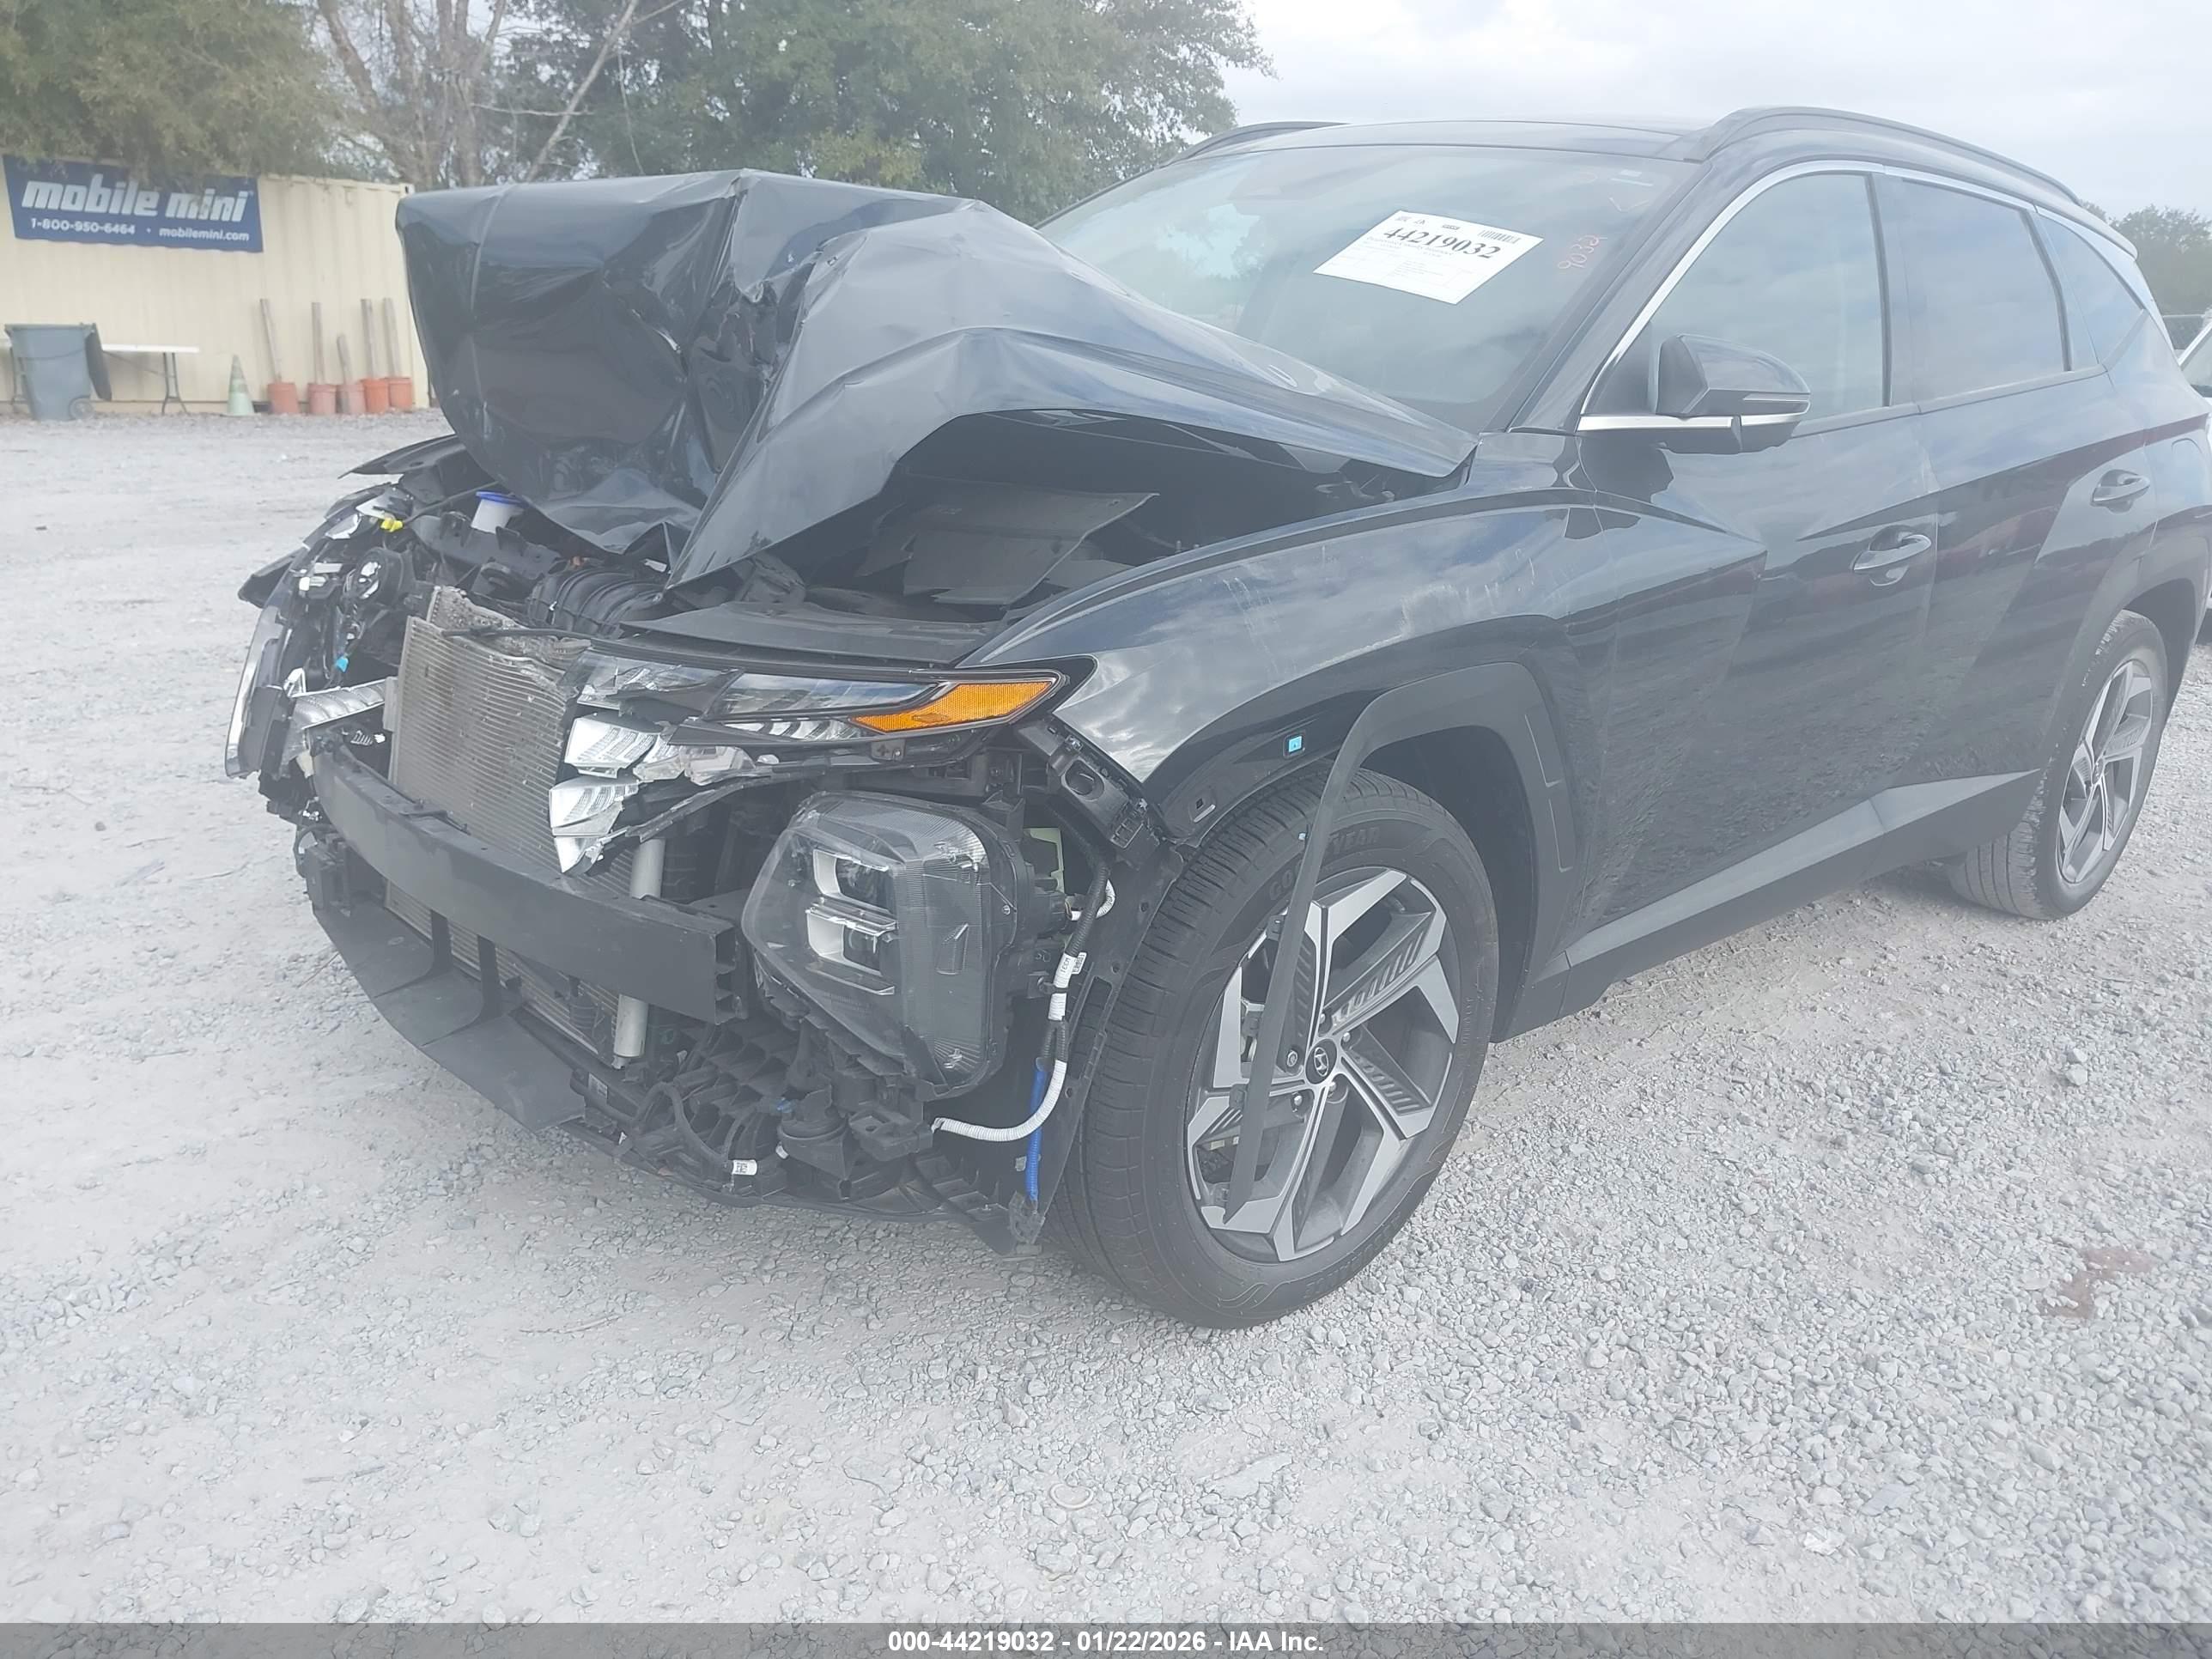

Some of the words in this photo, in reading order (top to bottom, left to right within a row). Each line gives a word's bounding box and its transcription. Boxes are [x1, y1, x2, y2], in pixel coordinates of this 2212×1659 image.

[21, 173, 161, 217] mobile
[164, 188, 249, 222] mini
[30, 217, 137, 235] 1-800-950-6464
[158, 226, 250, 241] mobilemini.com
[1383, 227, 1501, 258] 44219032
